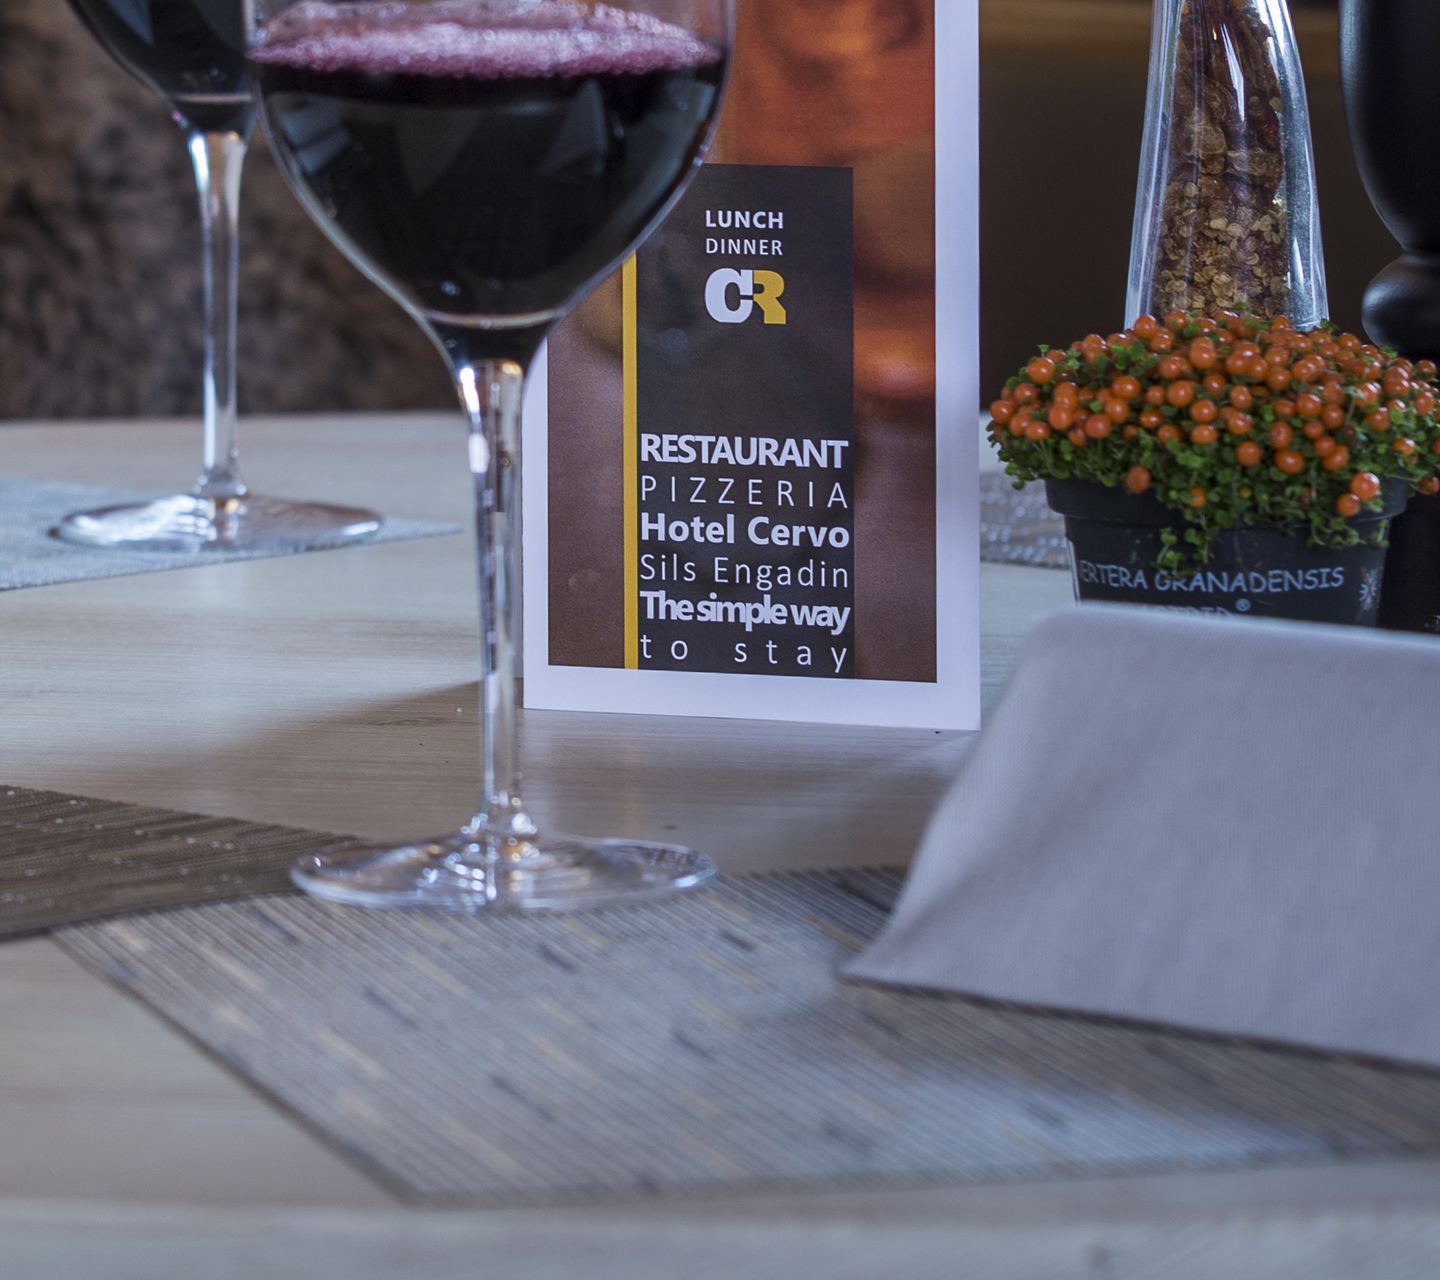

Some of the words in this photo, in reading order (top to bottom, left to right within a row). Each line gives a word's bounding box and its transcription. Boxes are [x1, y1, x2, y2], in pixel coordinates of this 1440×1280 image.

[705, 209, 784, 230] LUNCH
[705, 237, 784, 257] DINNER
[640, 433, 849, 469] RESTAURANT
[640, 475, 849, 509] PIZZERIA
[640, 512, 735, 544] Hotel
[747, 516, 850, 548] Cervo
[640, 553, 697, 582] Sils
[713, 556, 849, 591] Engadin
[1079, 559, 1148, 590] ERTERA
[1154, 567, 1345, 592] GRANADENSIS
[639, 590, 695, 621] The
[696, 592, 789, 632] simple
[790, 604, 851, 635] way
[640, 634, 689, 660] to
[734, 640, 848, 674] stay
